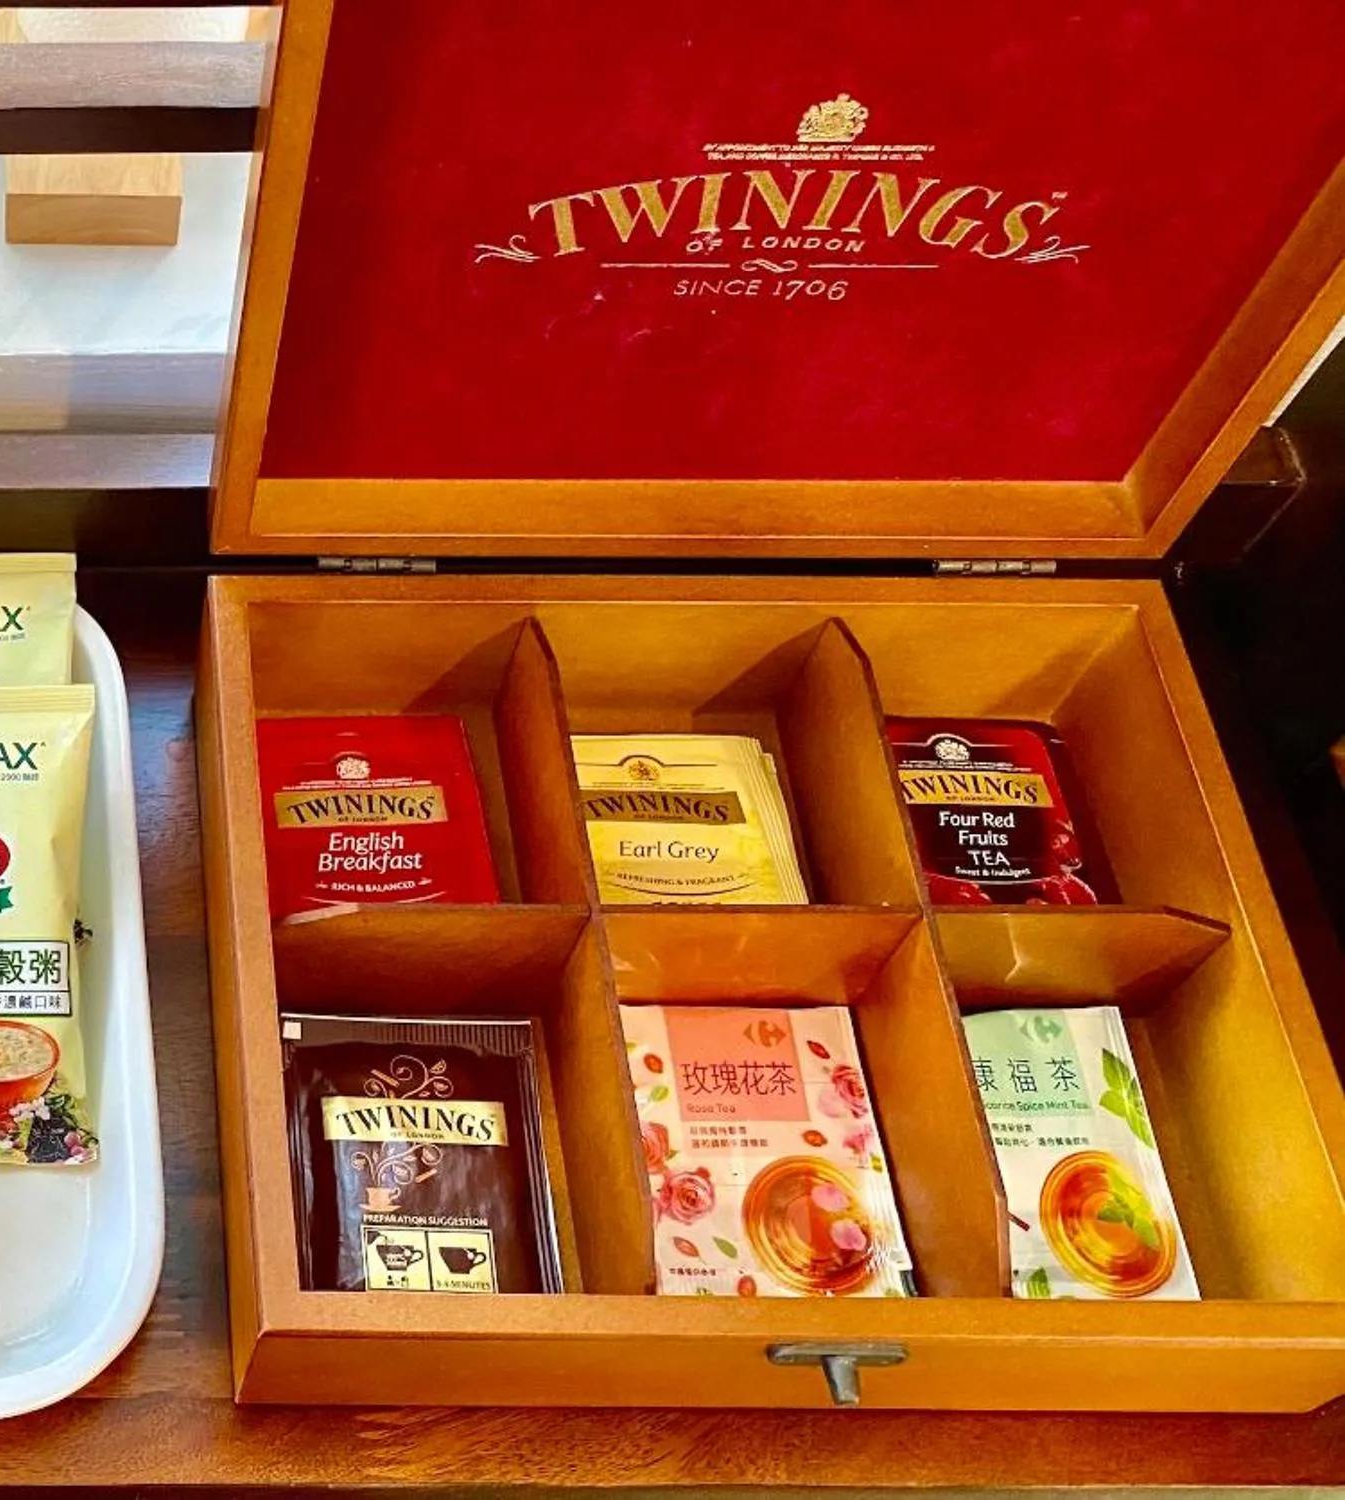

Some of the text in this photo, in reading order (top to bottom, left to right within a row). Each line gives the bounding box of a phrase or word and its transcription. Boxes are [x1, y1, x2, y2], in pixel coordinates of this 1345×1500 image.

[527, 170, 1063, 258] TWININGS
[685, 237, 866, 254] OF LONDON
[674, 280, 849, 301] SINCE 1706
[287, 794, 434, 824] TWININGS
[585, 792, 729, 821] TWININGS
[938, 810, 1015, 828] Four Red
[329, 831, 404, 855] English
[958, 830, 1008, 846] Fruits
[318, 850, 423, 874] Breakfast
[619, 840, 719, 863] Earl Grey
[967, 850, 1010, 866] TEA
[681, 1060, 797, 1096] 玫瑰花茶
[971, 1056, 1080, 1093] 康福茶
[686, 1103, 737, 1113] Rose Tea
[336, 1104, 495, 1141] TWININGS
[363, 1213, 425, 1224] PREPARATION
